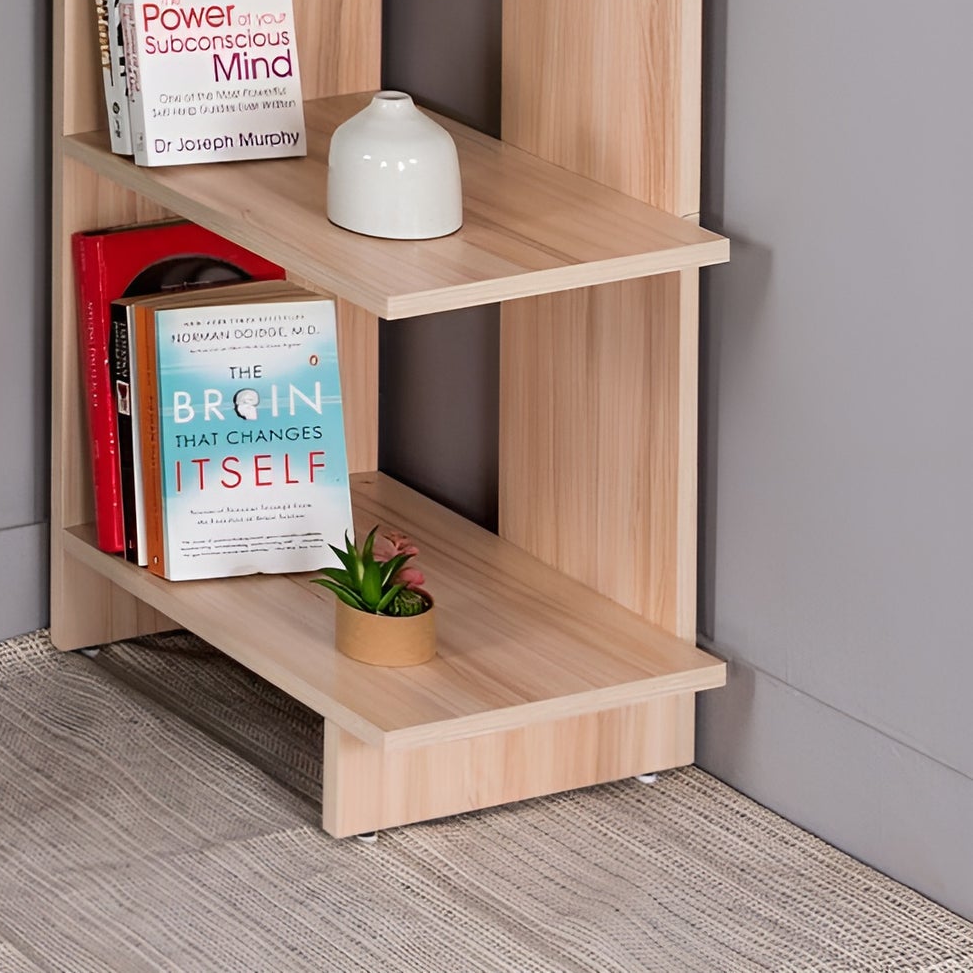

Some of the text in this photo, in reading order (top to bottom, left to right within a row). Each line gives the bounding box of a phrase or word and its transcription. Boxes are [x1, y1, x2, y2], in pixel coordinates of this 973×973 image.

[143, 3, 235, 32] Power
[145, 29, 290, 54] Subconscious
[213, 48, 293, 82] Mind
[154, 131, 300, 153] Dr Joseph Murphy
[229, 365, 262, 379] THE
[175, 425, 323, 448] THAT CHANGES
[175, 450, 325, 493] ITSELF
